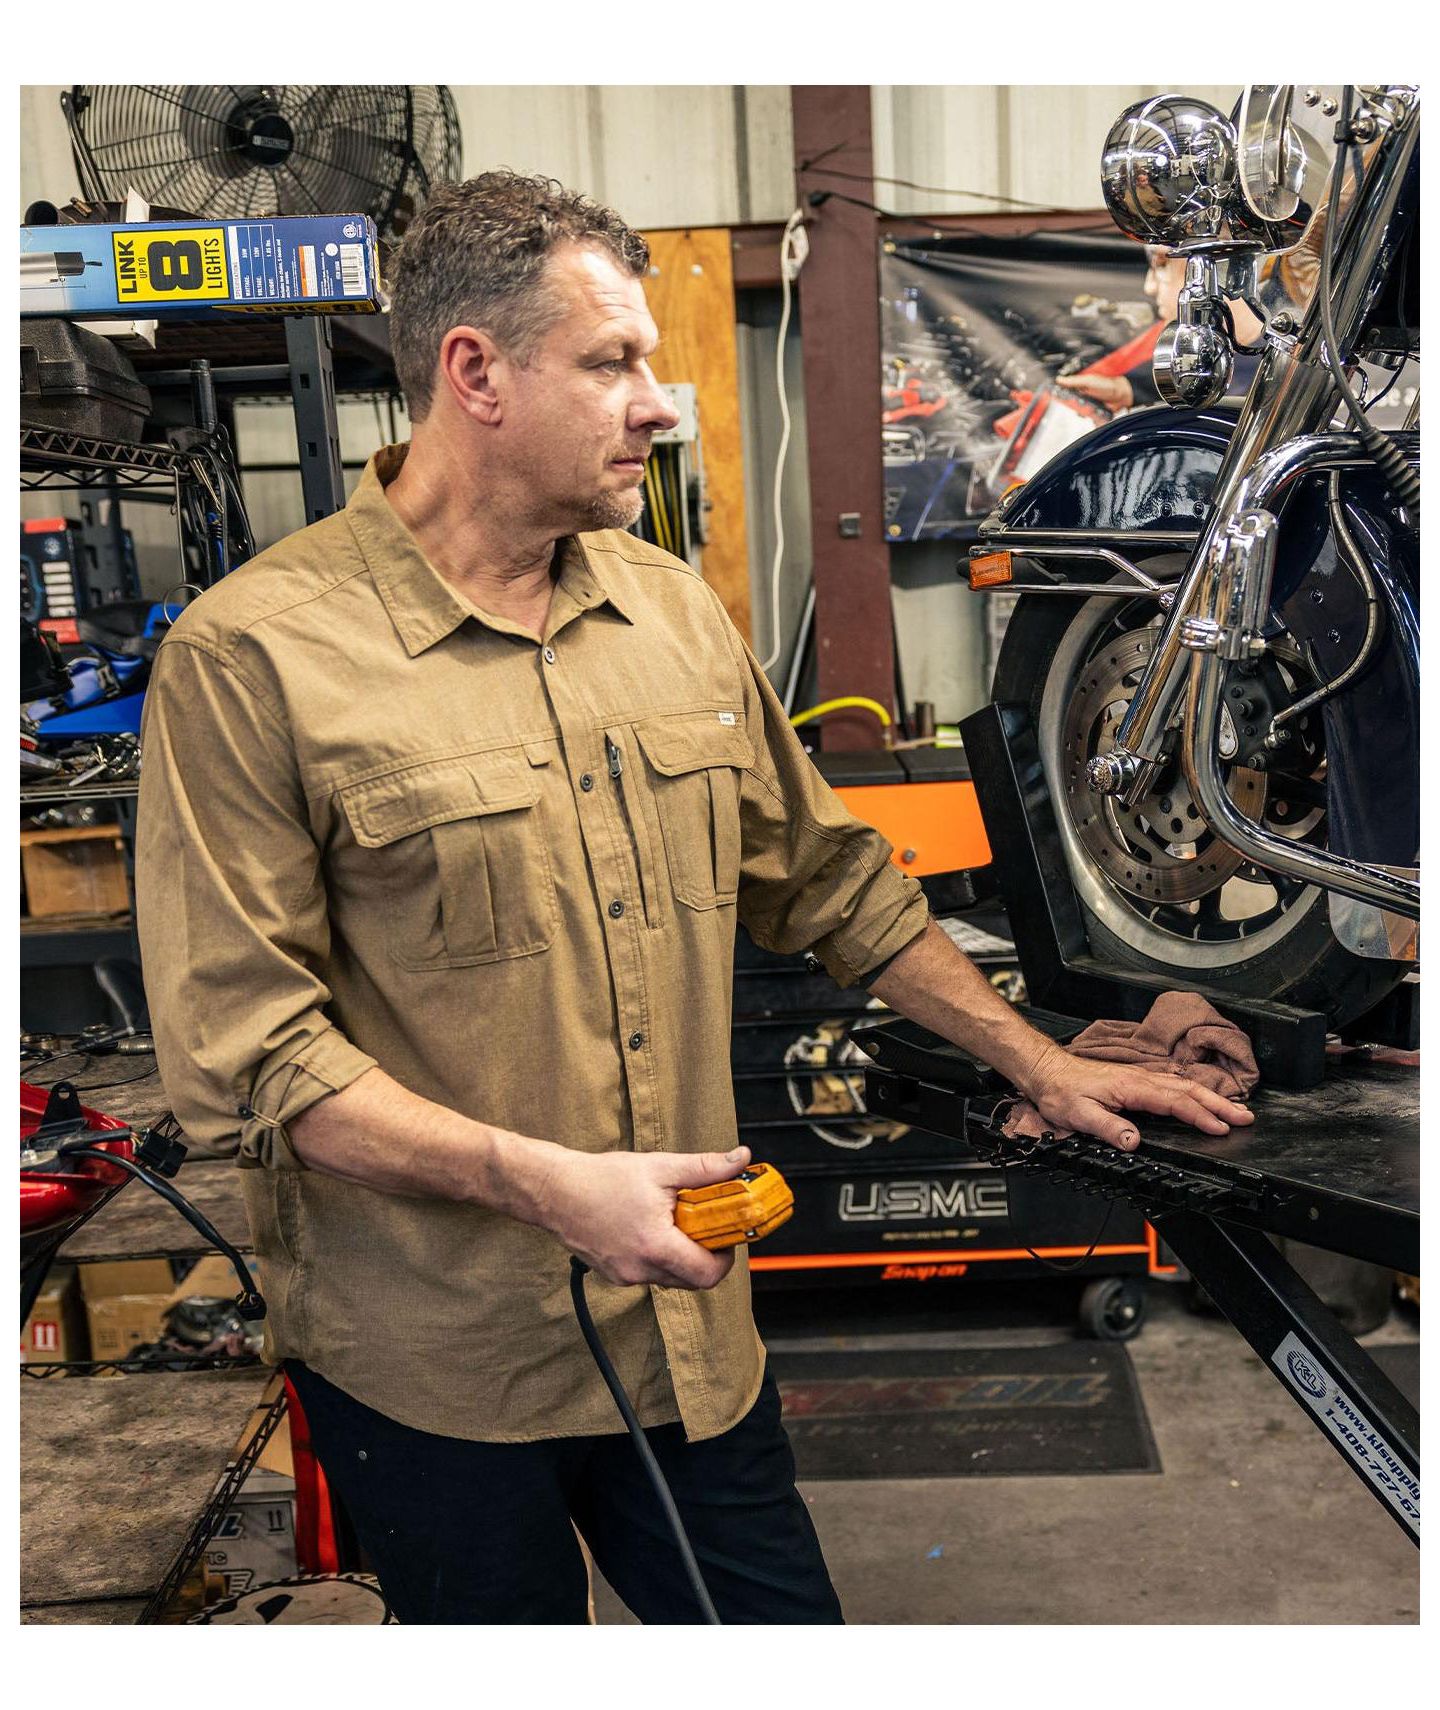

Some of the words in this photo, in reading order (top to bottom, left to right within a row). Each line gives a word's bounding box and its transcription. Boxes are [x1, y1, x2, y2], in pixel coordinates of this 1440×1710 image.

[118, 240, 137, 293] LINK
[138, 256, 147, 266] TO
[139, 268, 148, 279] UP
[147, 240, 204, 291] 8
[204, 238, 223, 289] LIGHTS
[838, 1178, 1009, 1222] USMC
[1324, 1407, 1420, 1526] 1-408-727-67
